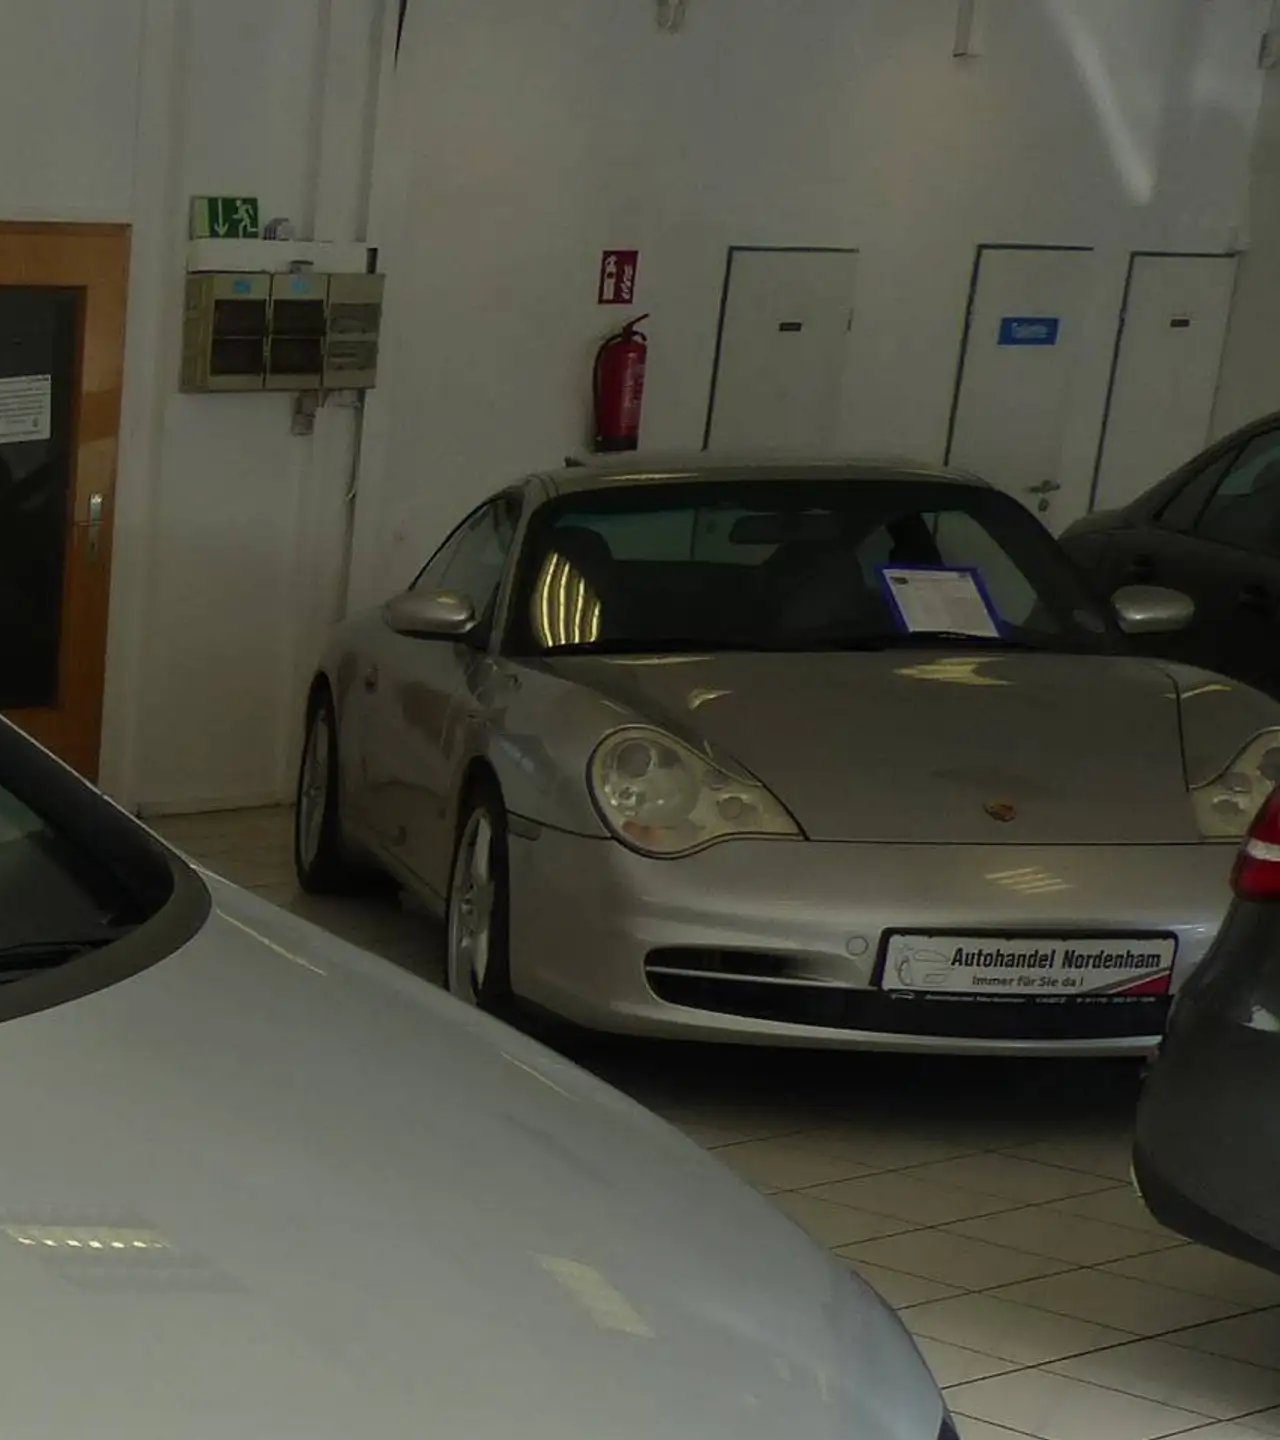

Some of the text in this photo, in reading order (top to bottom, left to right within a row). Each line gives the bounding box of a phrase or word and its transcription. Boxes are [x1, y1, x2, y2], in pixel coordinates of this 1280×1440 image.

[951, 947, 1162, 970] Autohandel Nordenham
[972, 975, 1015, 986] Immer
[1017, 975, 1037, 987] für
[1039, 976, 1060, 988] Sie
